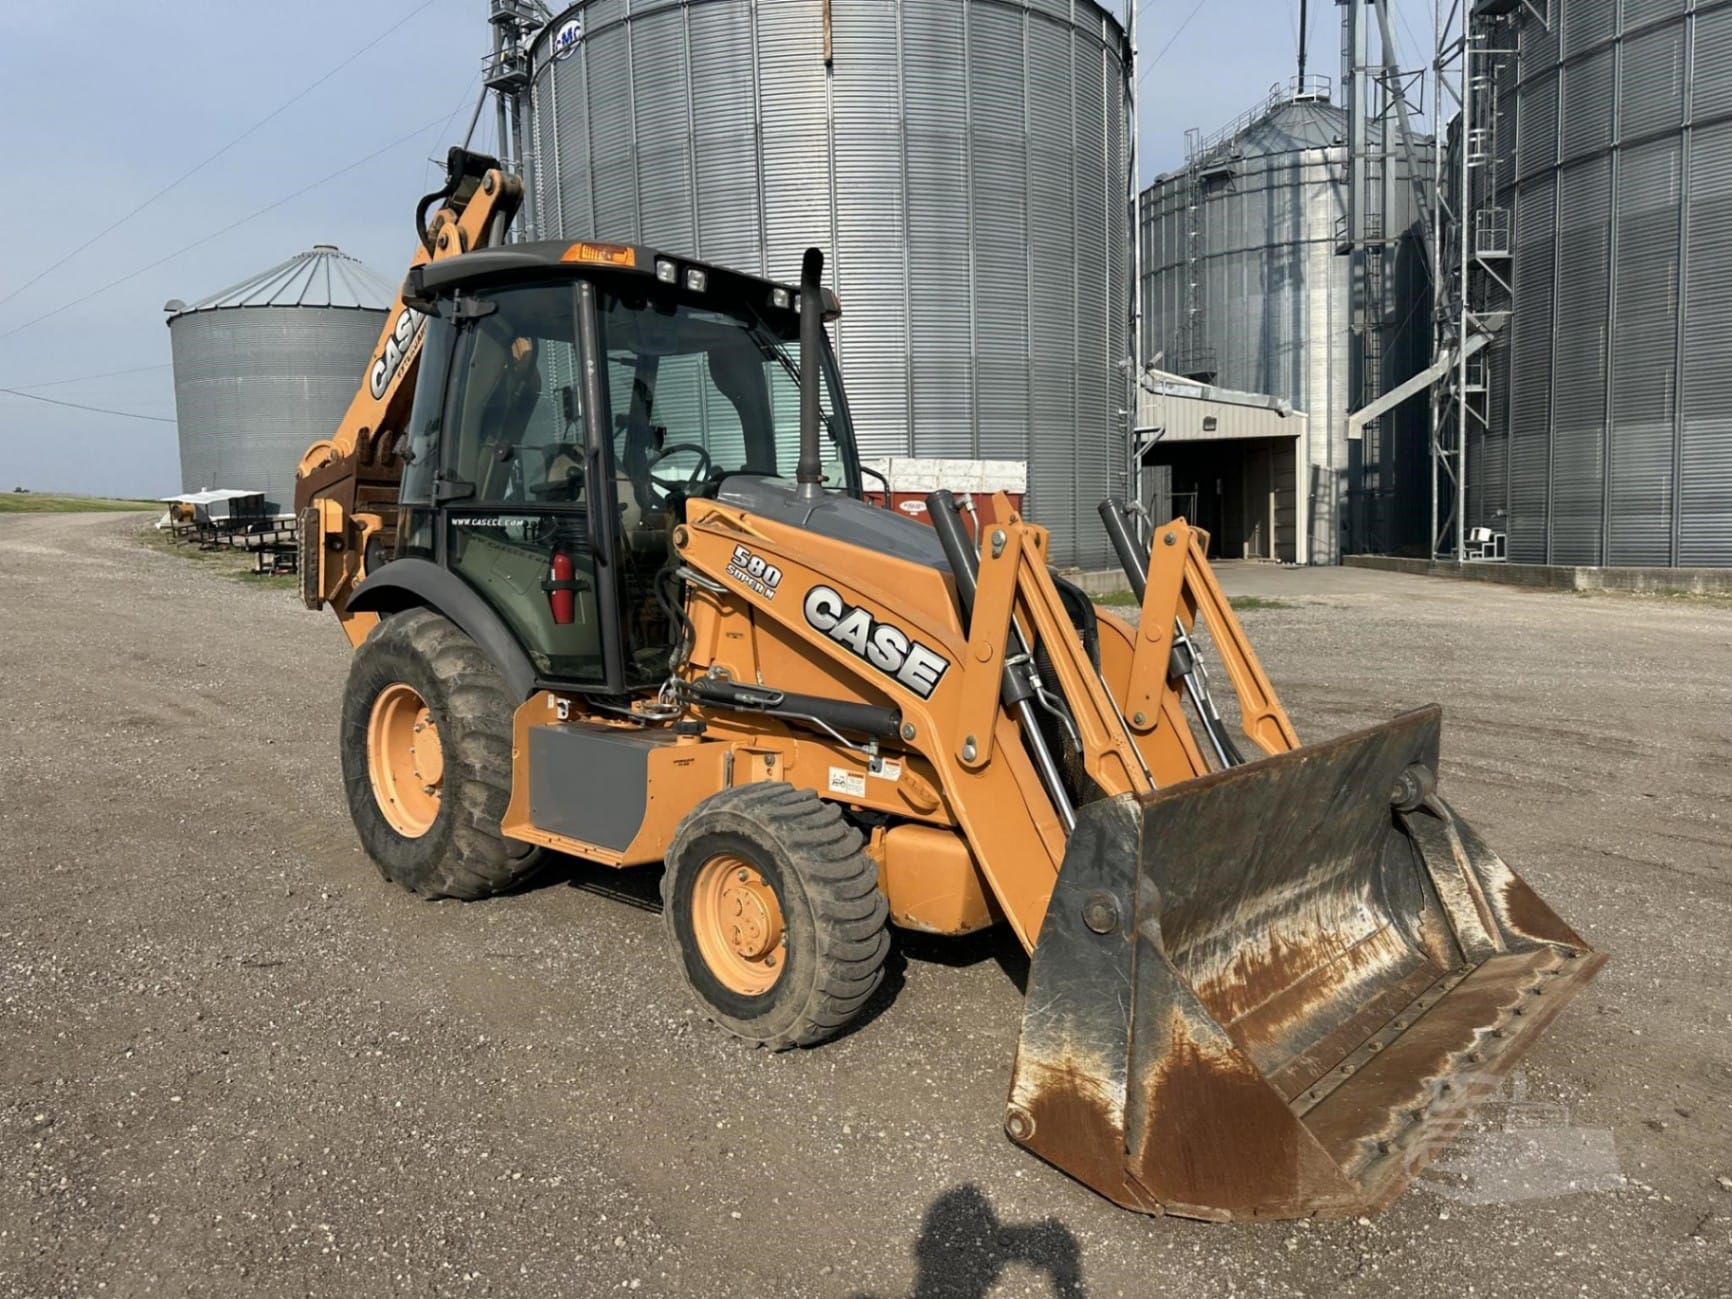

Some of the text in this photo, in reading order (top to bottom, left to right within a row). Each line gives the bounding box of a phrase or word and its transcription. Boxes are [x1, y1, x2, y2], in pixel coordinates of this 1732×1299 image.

[727, 564, 765, 594] SUPER
[731, 544, 783, 588] 580
[804, 584, 950, 700] CASE
